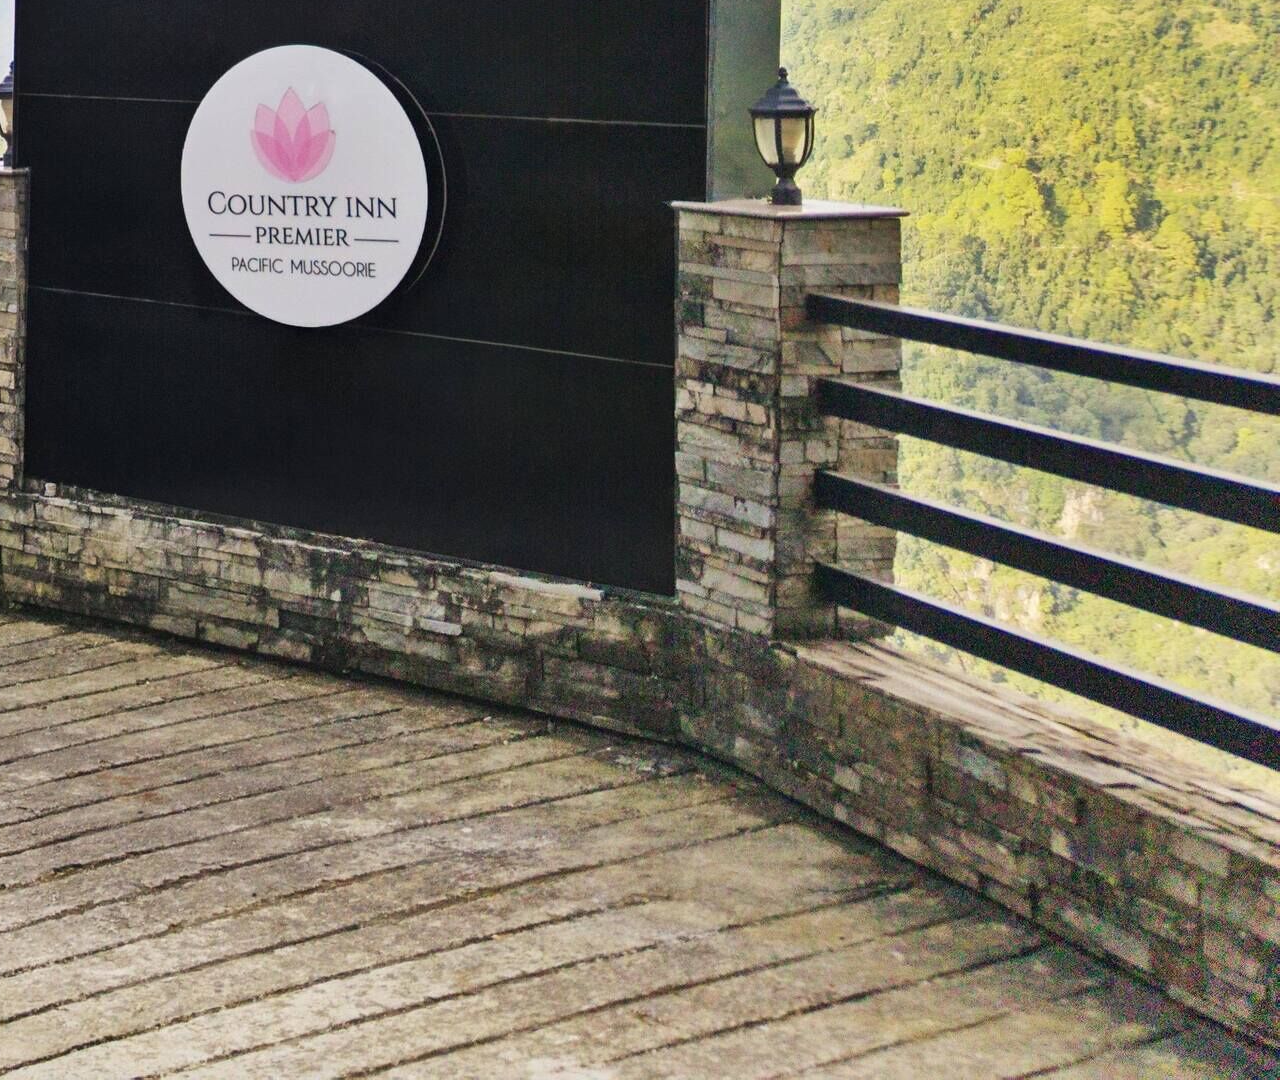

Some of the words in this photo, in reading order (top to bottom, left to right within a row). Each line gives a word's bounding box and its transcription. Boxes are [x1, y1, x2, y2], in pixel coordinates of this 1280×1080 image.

[207, 191, 338, 216] COUNTRY
[346, 196, 398, 219] INN
[255, 226, 351, 247] PREMIER
[231, 257, 284, 274] PACIFIC
[290, 259, 376, 278] MUSSOORIE
